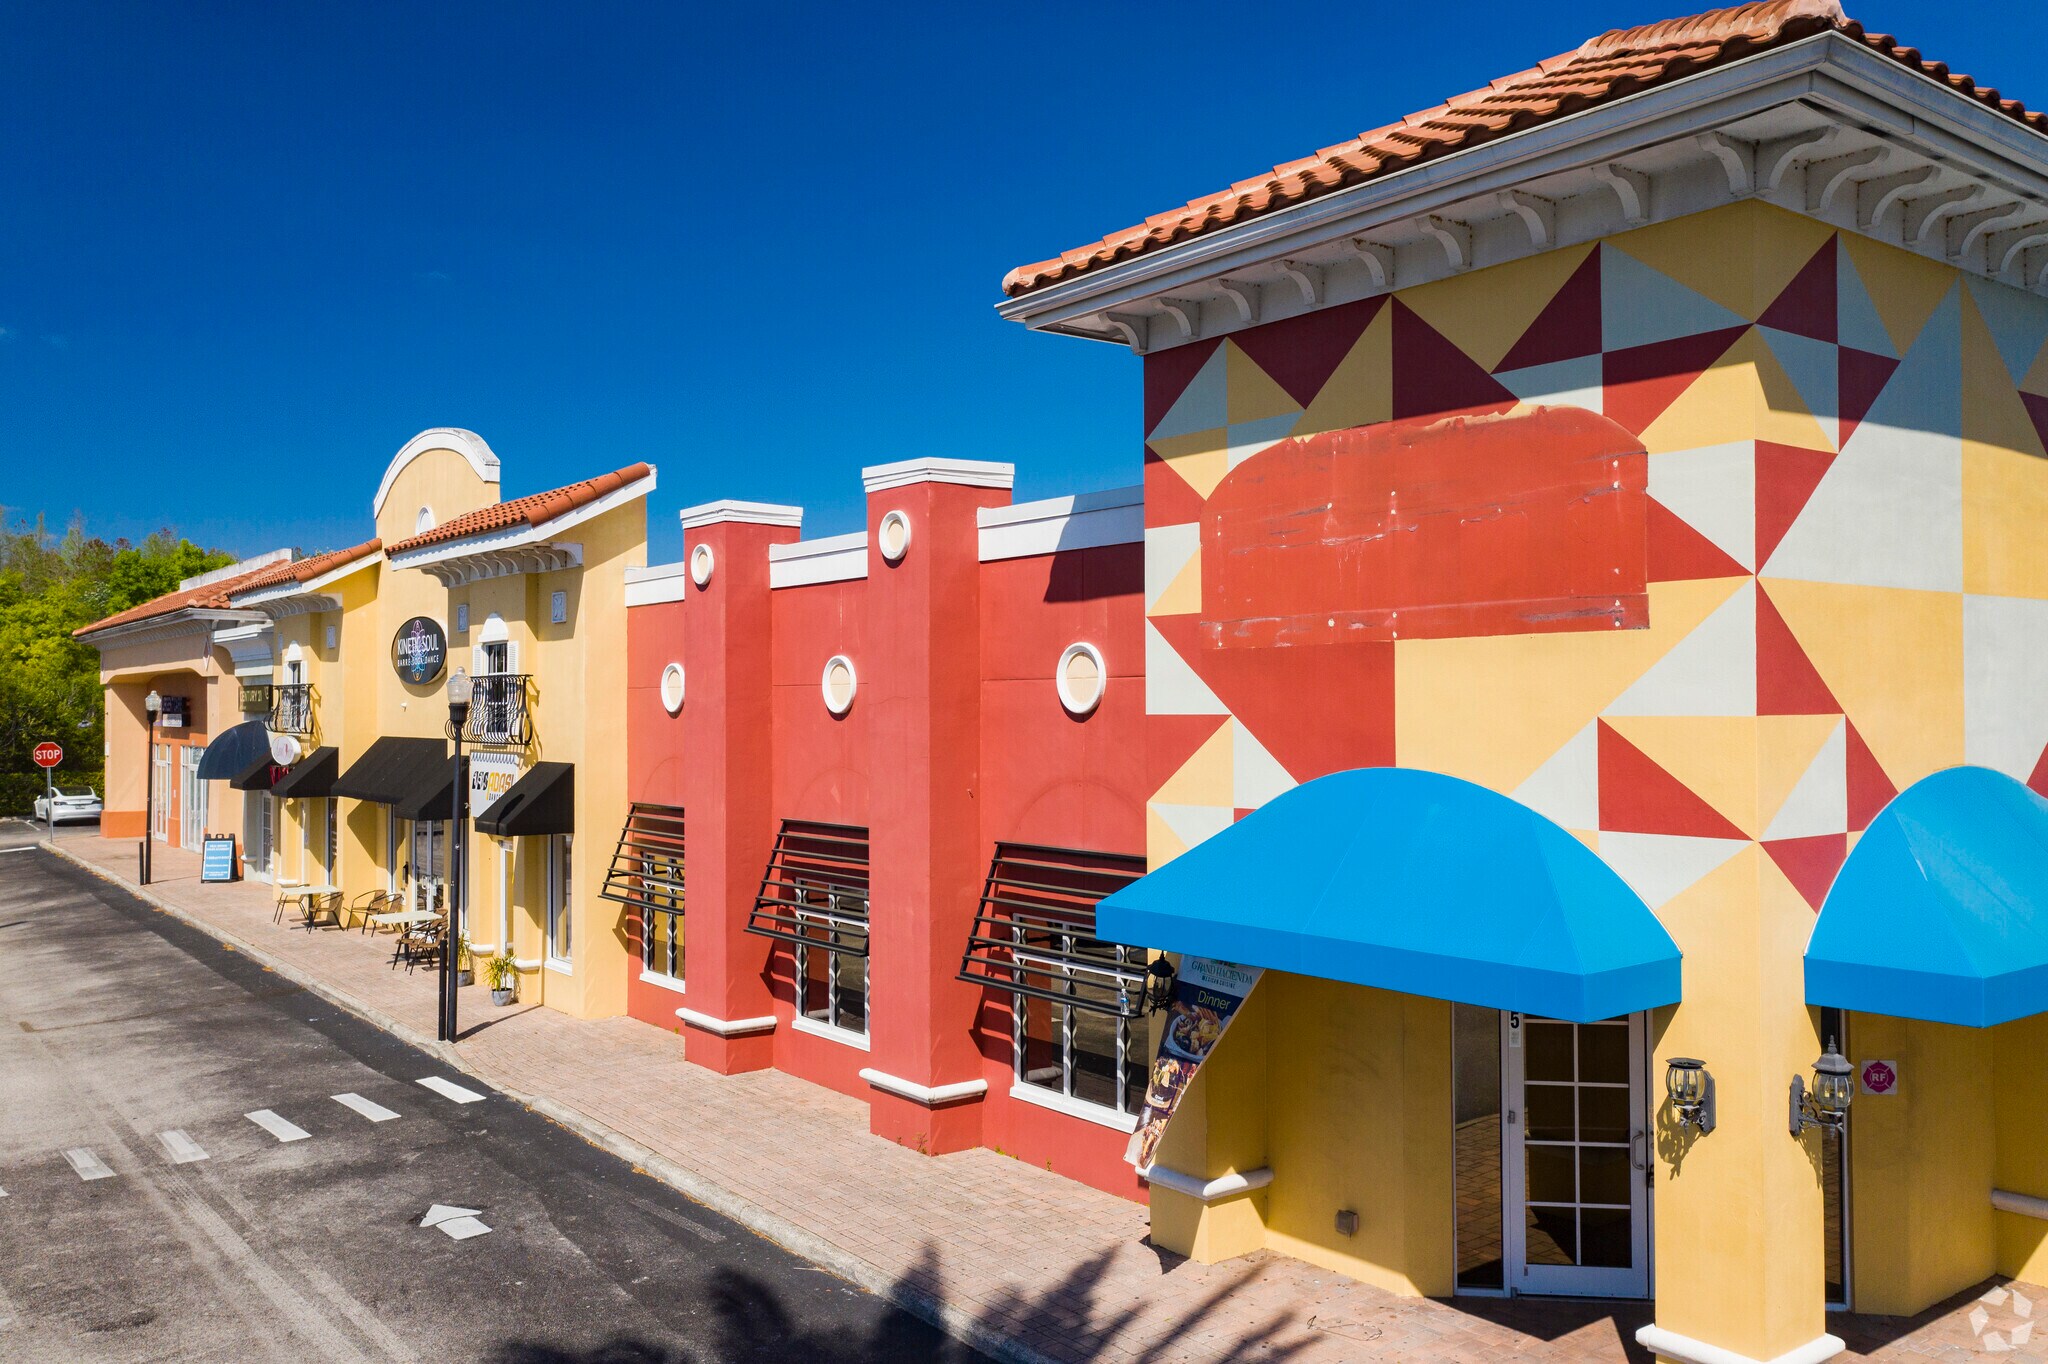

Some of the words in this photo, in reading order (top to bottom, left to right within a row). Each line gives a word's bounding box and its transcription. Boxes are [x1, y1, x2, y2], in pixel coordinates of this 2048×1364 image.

[421, 634, 439, 651] SOUL
[425, 654, 440, 664] DANCE
[35, 749, 61, 760] STOP
[1191, 960, 1216, 975] GRAND
[1215, 966, 1254, 985] HACIENDA
[1201, 975, 1219, 985] MEXICAN
[1219, 981, 1236, 989] CUISINE
[1197, 990, 1231, 1010] Dinner
[1510, 1011, 1520, 1029] 5
[1871, 1073, 1886, 1082] RF
